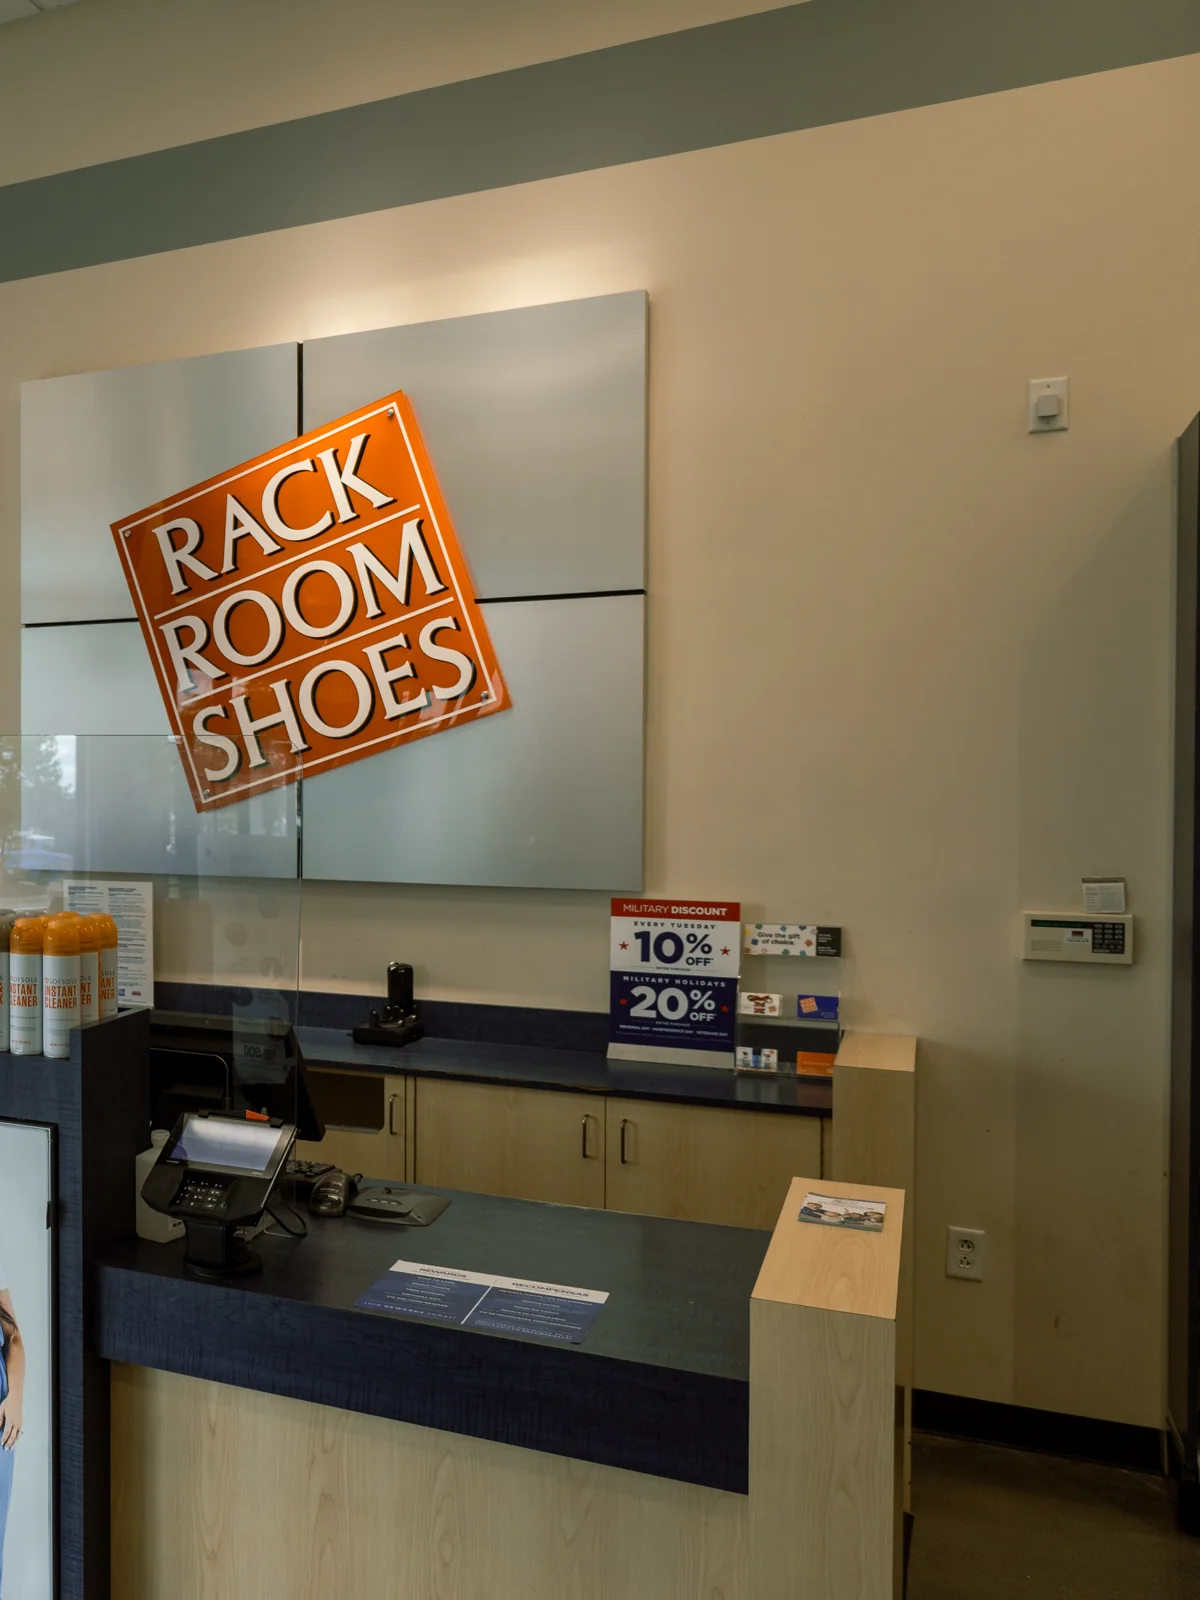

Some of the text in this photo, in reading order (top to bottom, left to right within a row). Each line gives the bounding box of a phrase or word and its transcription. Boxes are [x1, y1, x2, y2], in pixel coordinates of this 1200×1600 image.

[151, 432, 398, 597] RACK
[159, 517, 449, 693] ROOM
[192, 616, 477, 783] SHOES
[623, 904, 728, 916] MILITARY DISCOUNT
[671, 922, 716, 930] TUESDAY
[634, 930, 712, 964] 10%
[45, 985, 77, 997] INSTANT
[623, 975, 726, 988] MILITARY HOLIDAYS
[45, 997, 77, 1009] CLEANER
[630, 985, 716, 1020] 20%
